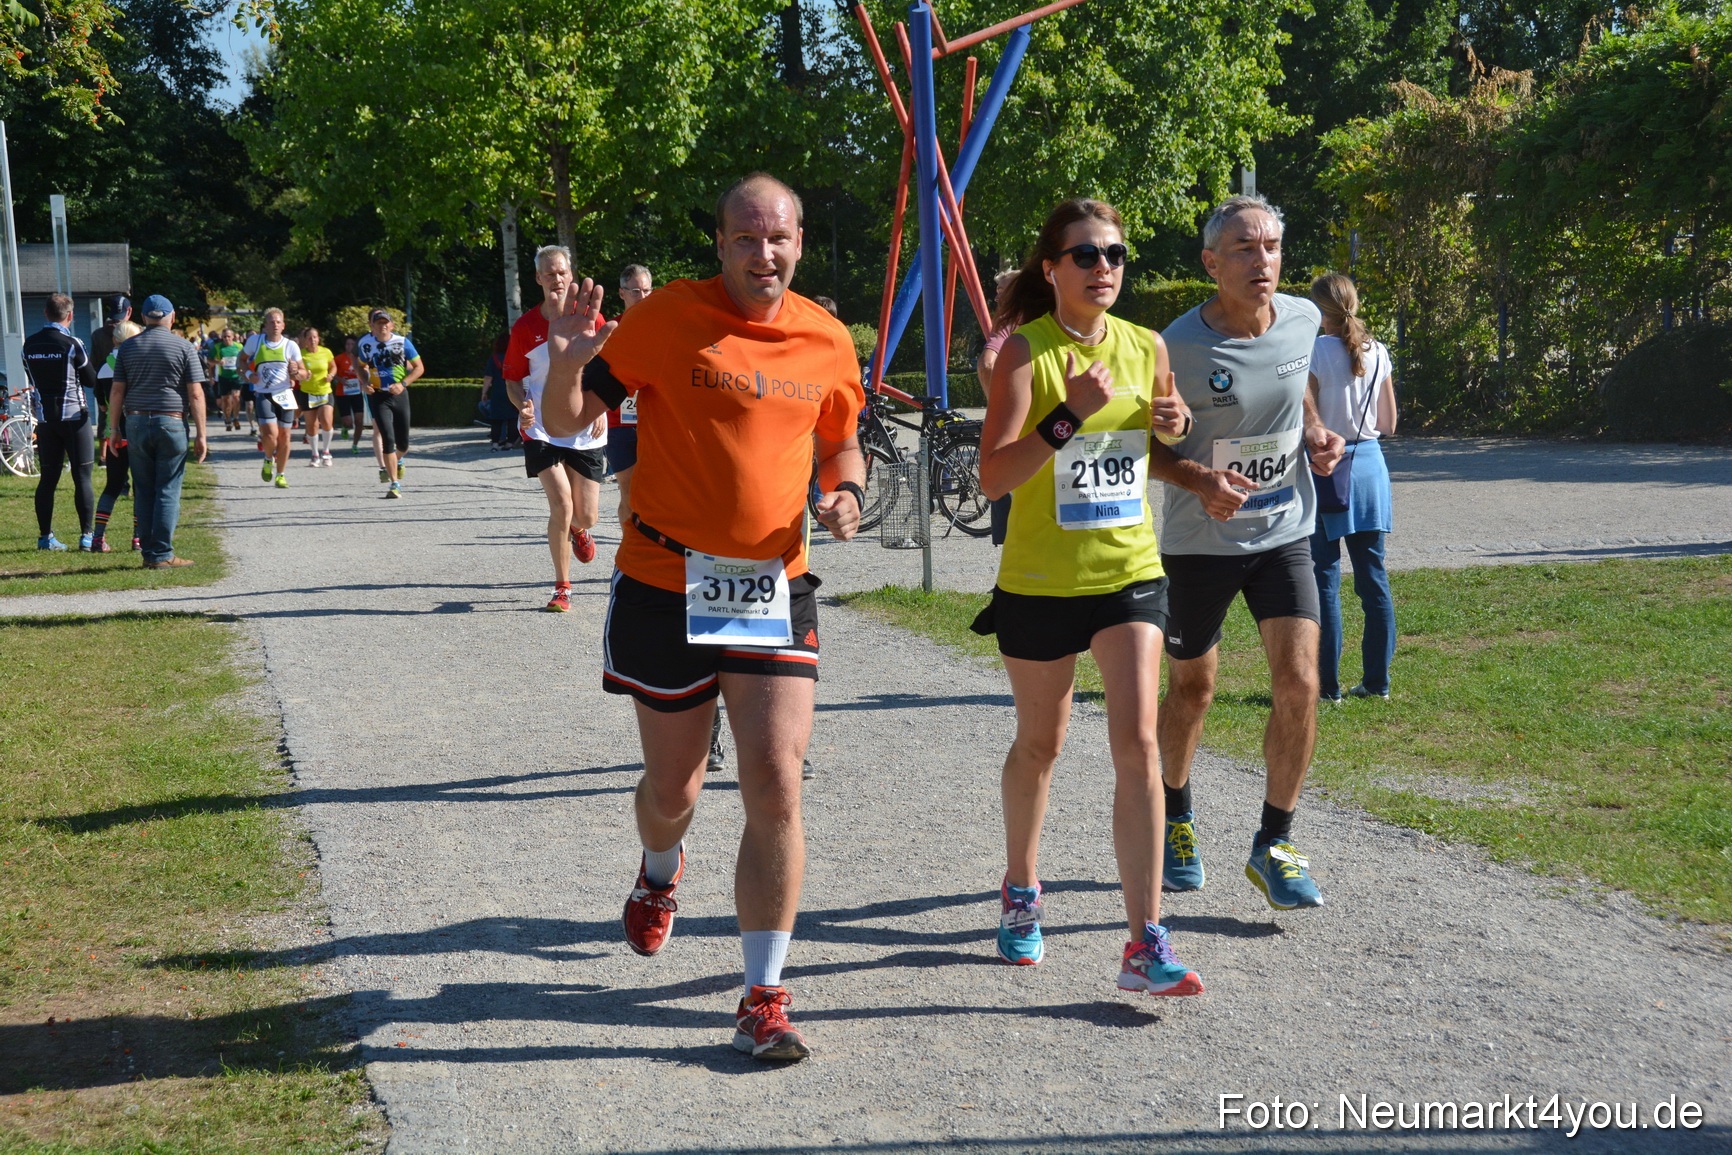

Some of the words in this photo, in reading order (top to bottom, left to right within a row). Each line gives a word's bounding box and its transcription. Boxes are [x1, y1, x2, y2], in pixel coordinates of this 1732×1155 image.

[1275, 355, 1309, 376] BOCK
[691, 368, 751, 392] EURO
[771, 378, 823, 402] POLES
[1211, 394, 1239, 403] PARTL
[1240, 440, 1279, 454] BOCK
[1070, 456, 1136, 489] 2198
[1099, 490, 1126, 498] Neumarkt
[1241, 494, 1280, 510] olfgang
[1095, 504, 1120, 517] Nina
[702, 574, 777, 604] 3129
[708, 606, 730, 614] PARTL
[731, 606, 761, 615] Neumarkt
